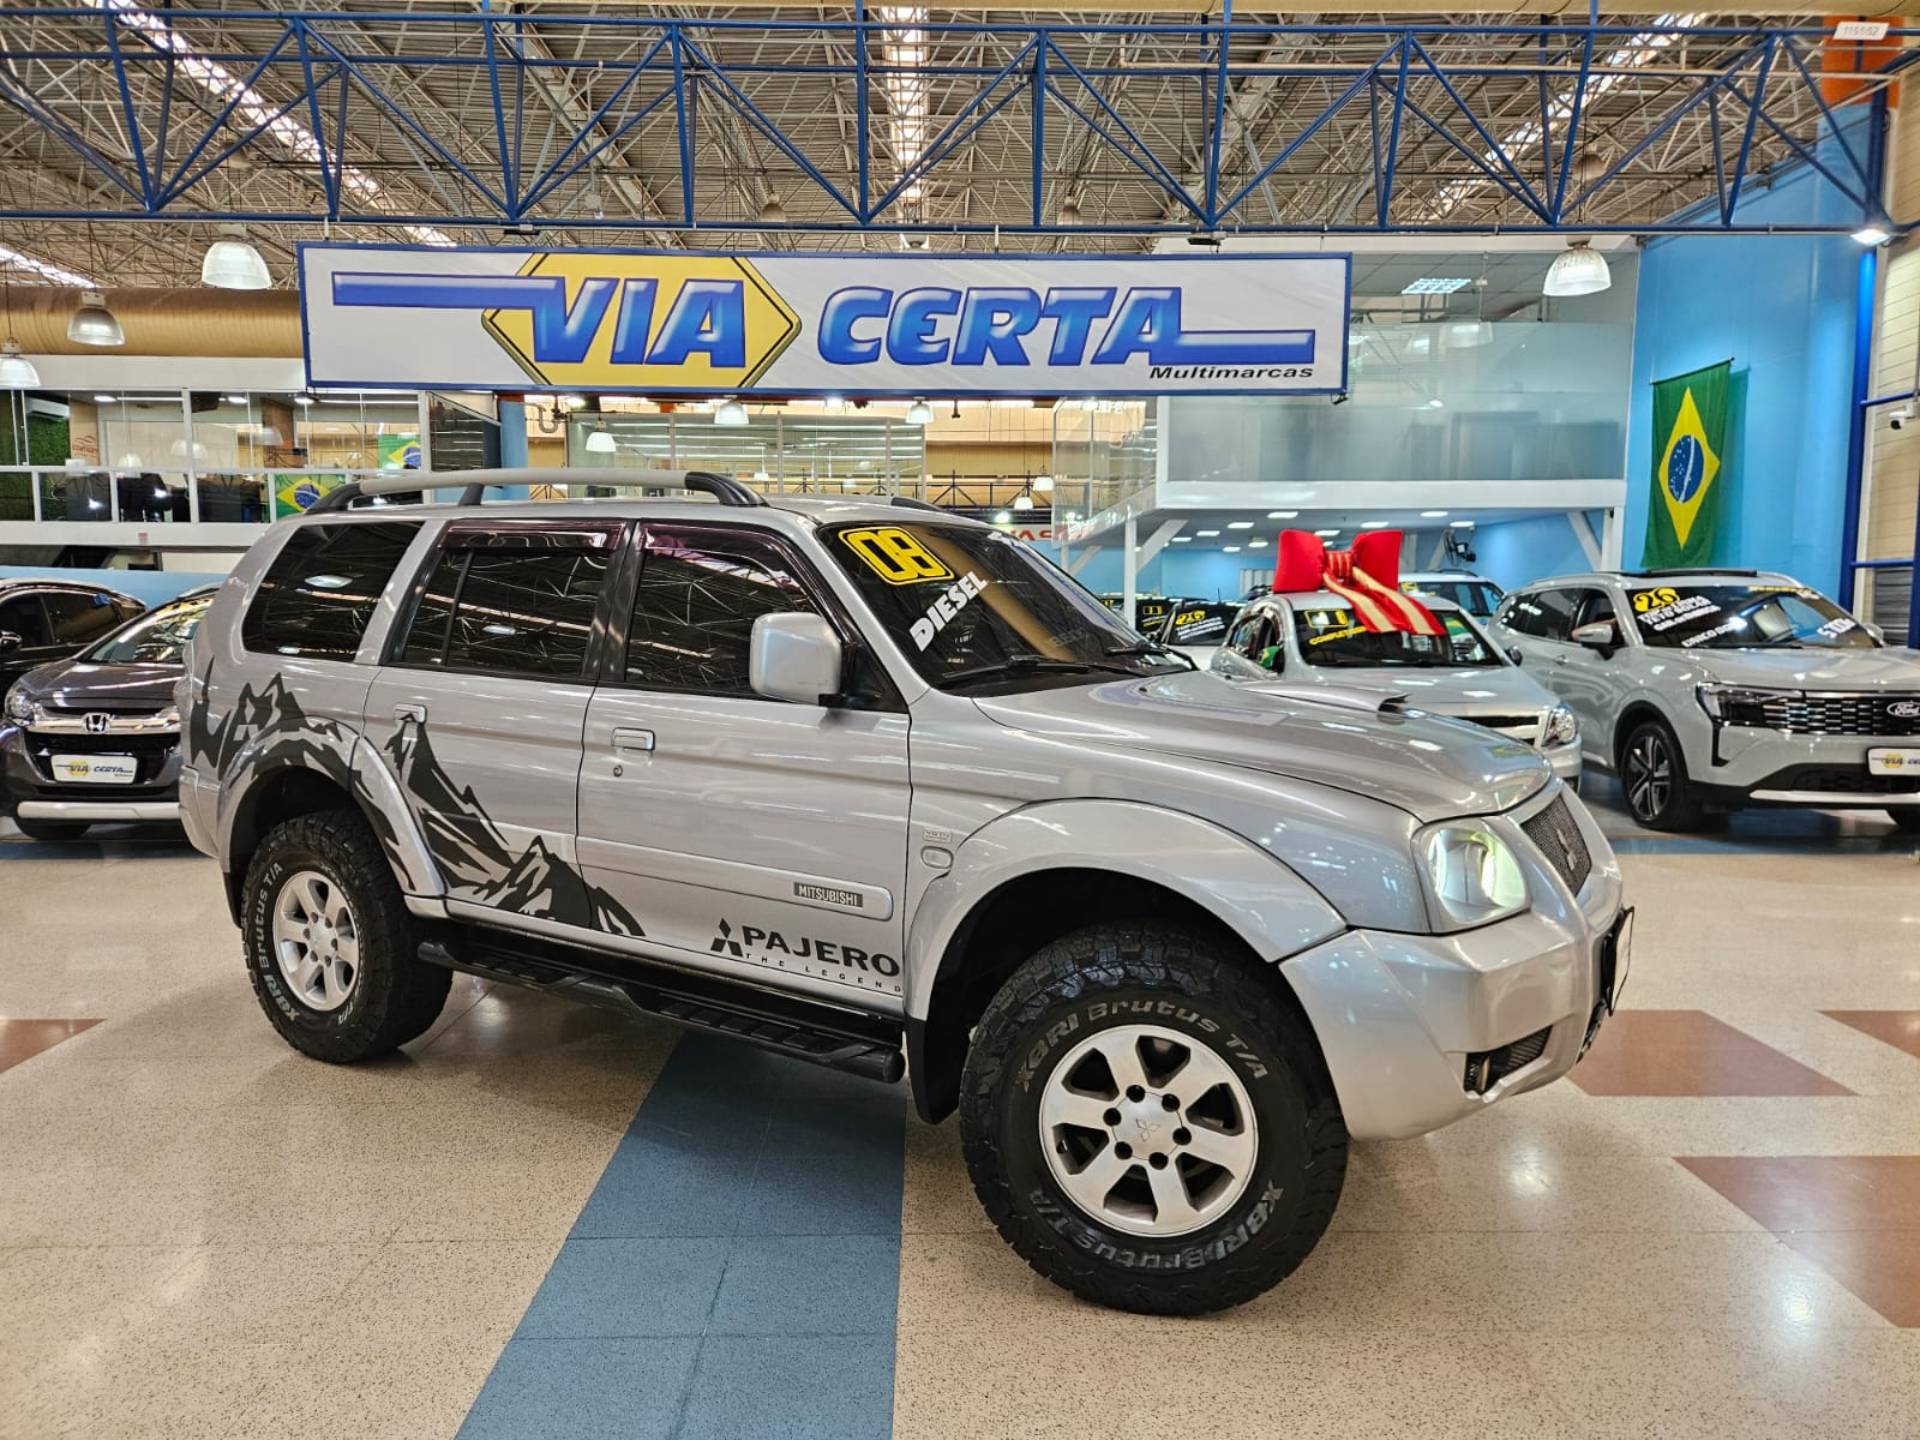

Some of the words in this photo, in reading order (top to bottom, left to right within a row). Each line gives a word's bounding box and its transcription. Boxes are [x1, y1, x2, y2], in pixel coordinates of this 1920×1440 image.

[524, 276, 746, 368] VIA
[817, 286, 1184, 367] CERTA
[1148, 365, 1314, 380] Multimarcas
[846, 529, 947, 582] 08
[908, 570, 991, 653] DIESEL
[69, 764, 89, 773] VIA
[93, 764, 126, 773] CERTA
[262, 861, 284, 887] T/A
[797, 884, 859, 907] MITSUBISHI
[254, 888, 271, 969] Brutus
[741, 925, 901, 978] PAJERO
[263, 973, 300, 1022] XBRI
[745, 952, 786, 968] THE
[804, 965, 903, 994] LEGEND
[1014, 1012, 1080, 1094] XBRI
[1087, 1000, 1221, 1034] Brutus
[1226, 1032, 1269, 1080] T/A
[1072, 1232, 1206, 1270] Brutus
